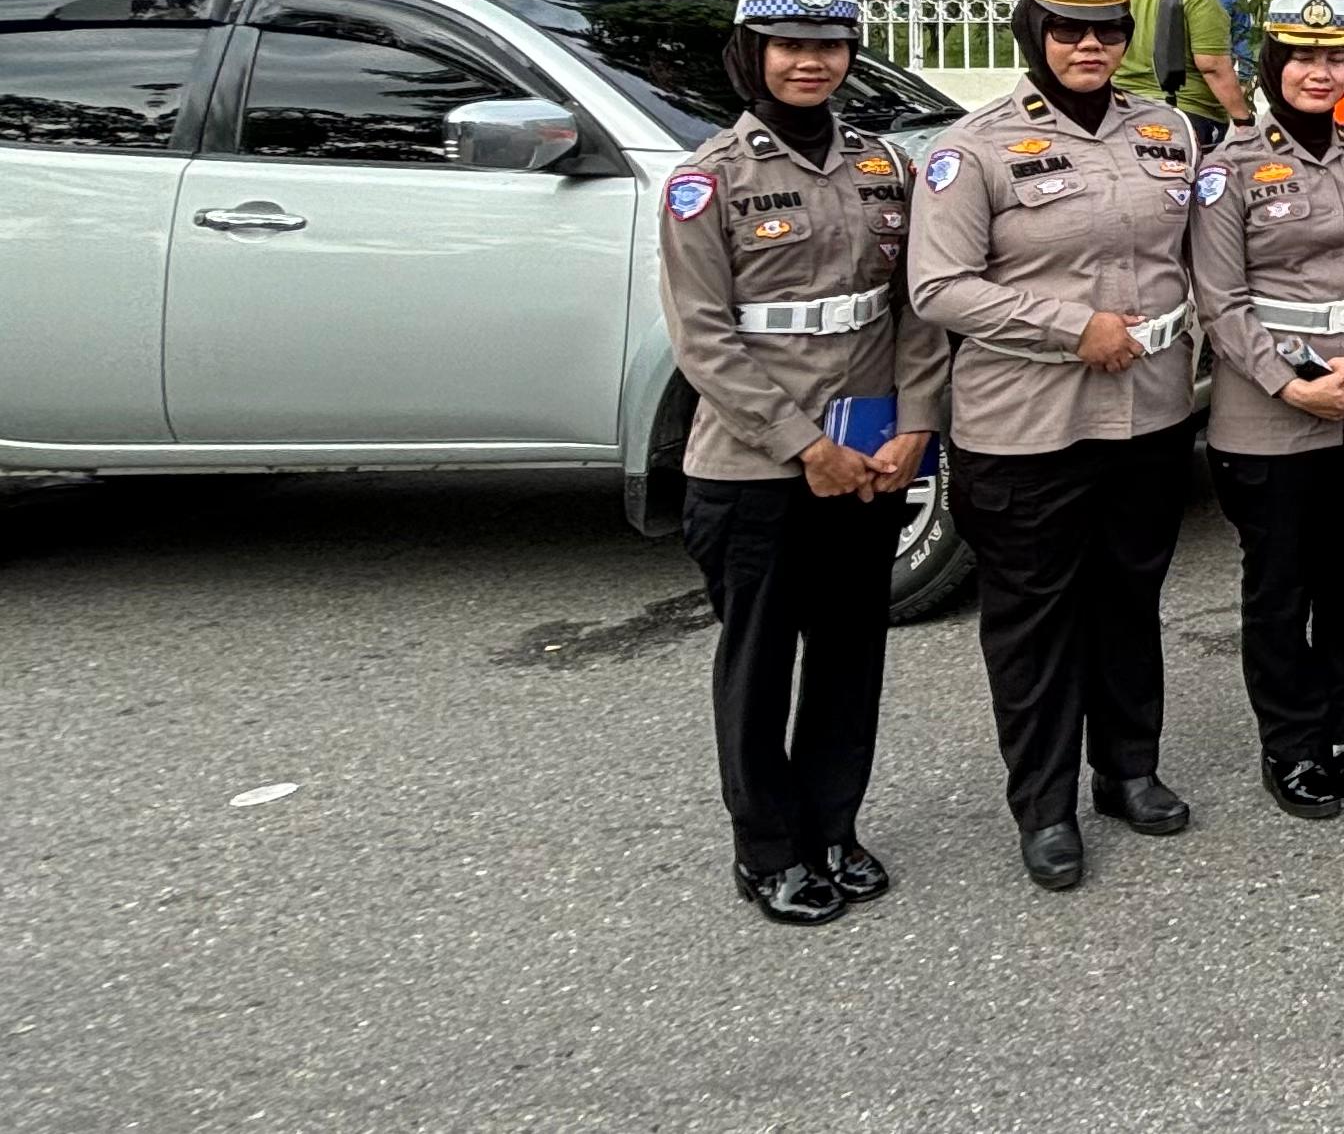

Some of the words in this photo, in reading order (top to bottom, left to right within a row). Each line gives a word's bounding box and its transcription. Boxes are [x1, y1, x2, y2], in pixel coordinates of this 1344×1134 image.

[1134, 144, 1187, 163] POLRI
[1249, 181, 1301, 201] KRIS
[729, 191, 802, 216] YUNI
